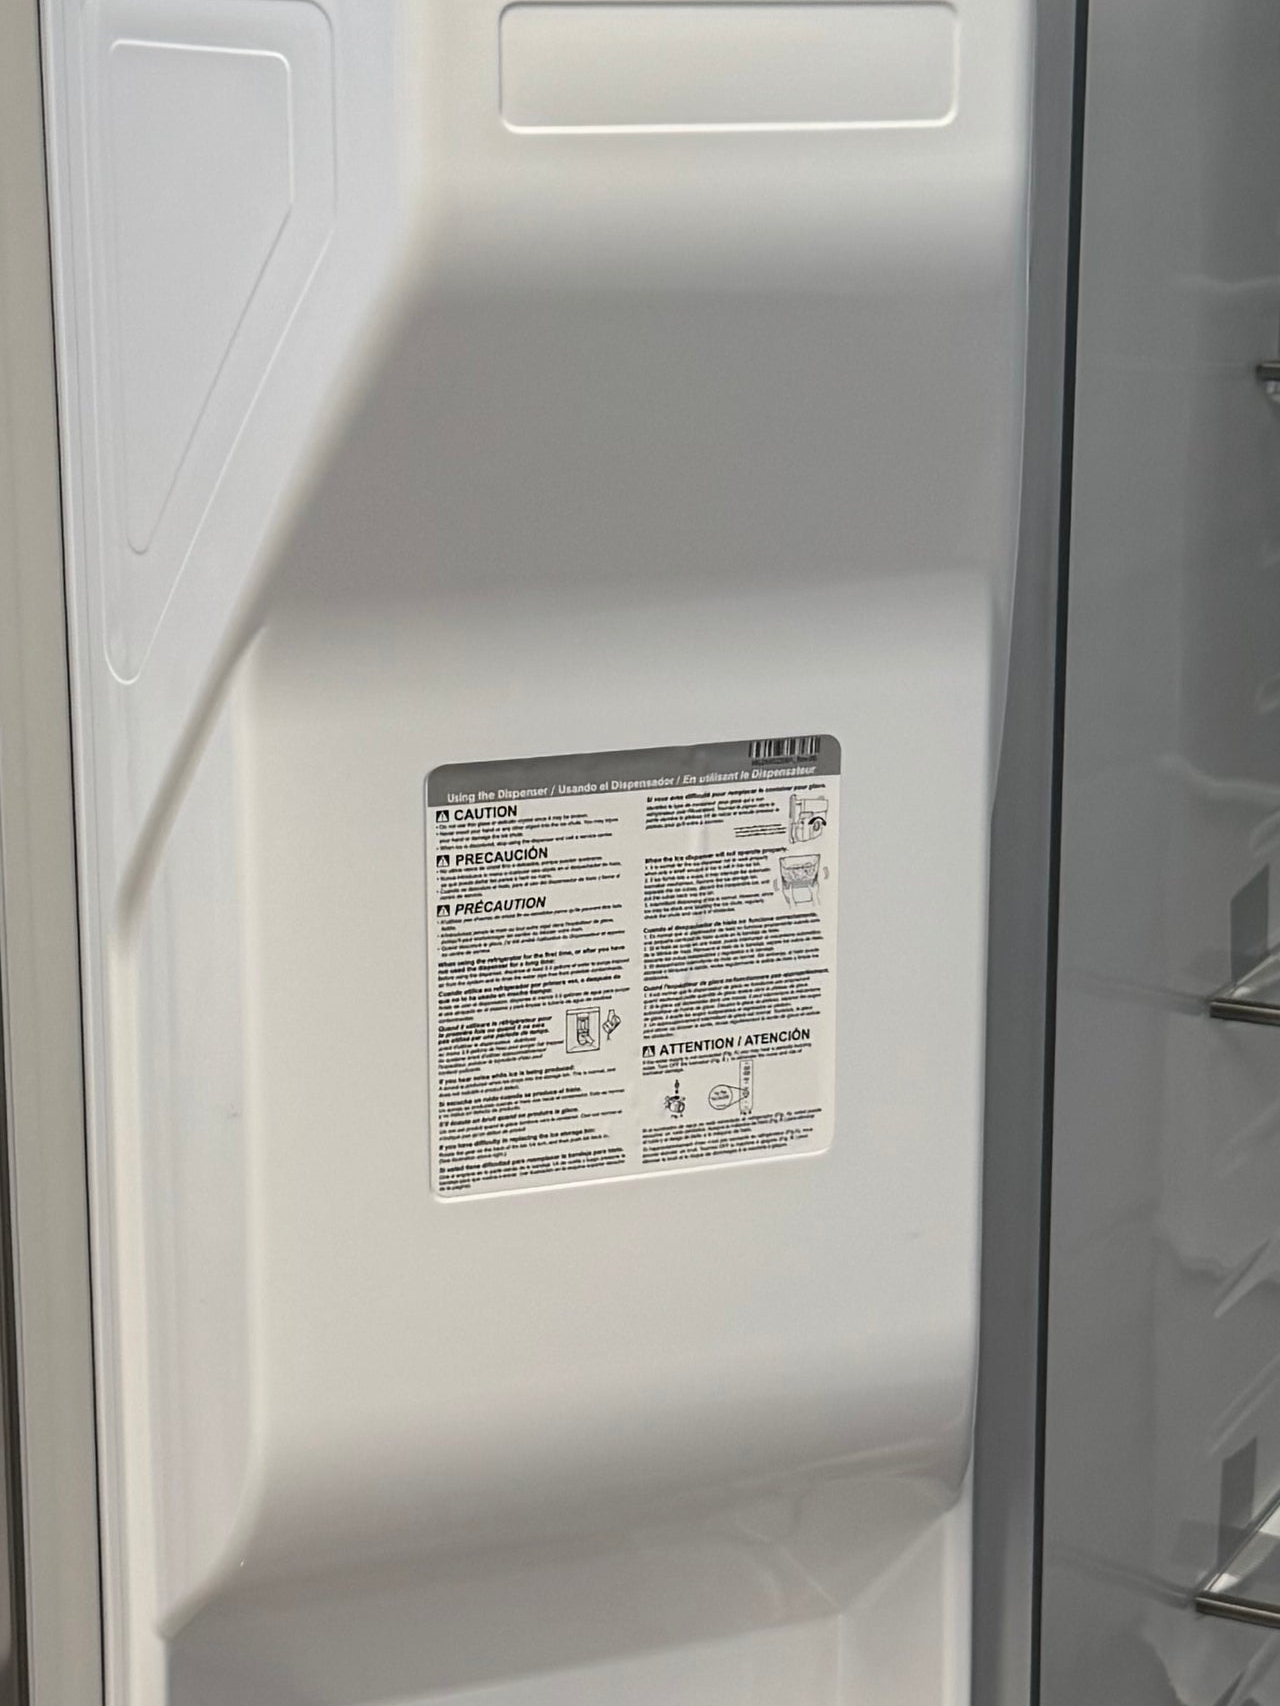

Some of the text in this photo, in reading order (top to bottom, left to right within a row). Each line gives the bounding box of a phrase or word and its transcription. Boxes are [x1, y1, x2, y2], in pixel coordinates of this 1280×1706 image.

[447, 791, 476, 804] Using
[478, 789, 495, 801] the
[498, 785, 548, 801] Dispenser
[558, 781, 597, 794] Usando
[599, 780, 609, 791] el
[611, 775, 675, 792] Dispensador
[683, 773, 697, 784] En
[454, 804, 518, 821] CAUTION
[455, 845, 548, 866] PRECAUCIÓN
[454, 896, 547, 916] PRÉCAUTION
[659, 1037, 734, 1056] ATTENTION
[744, 1027, 811, 1047] ATENCIÓN
